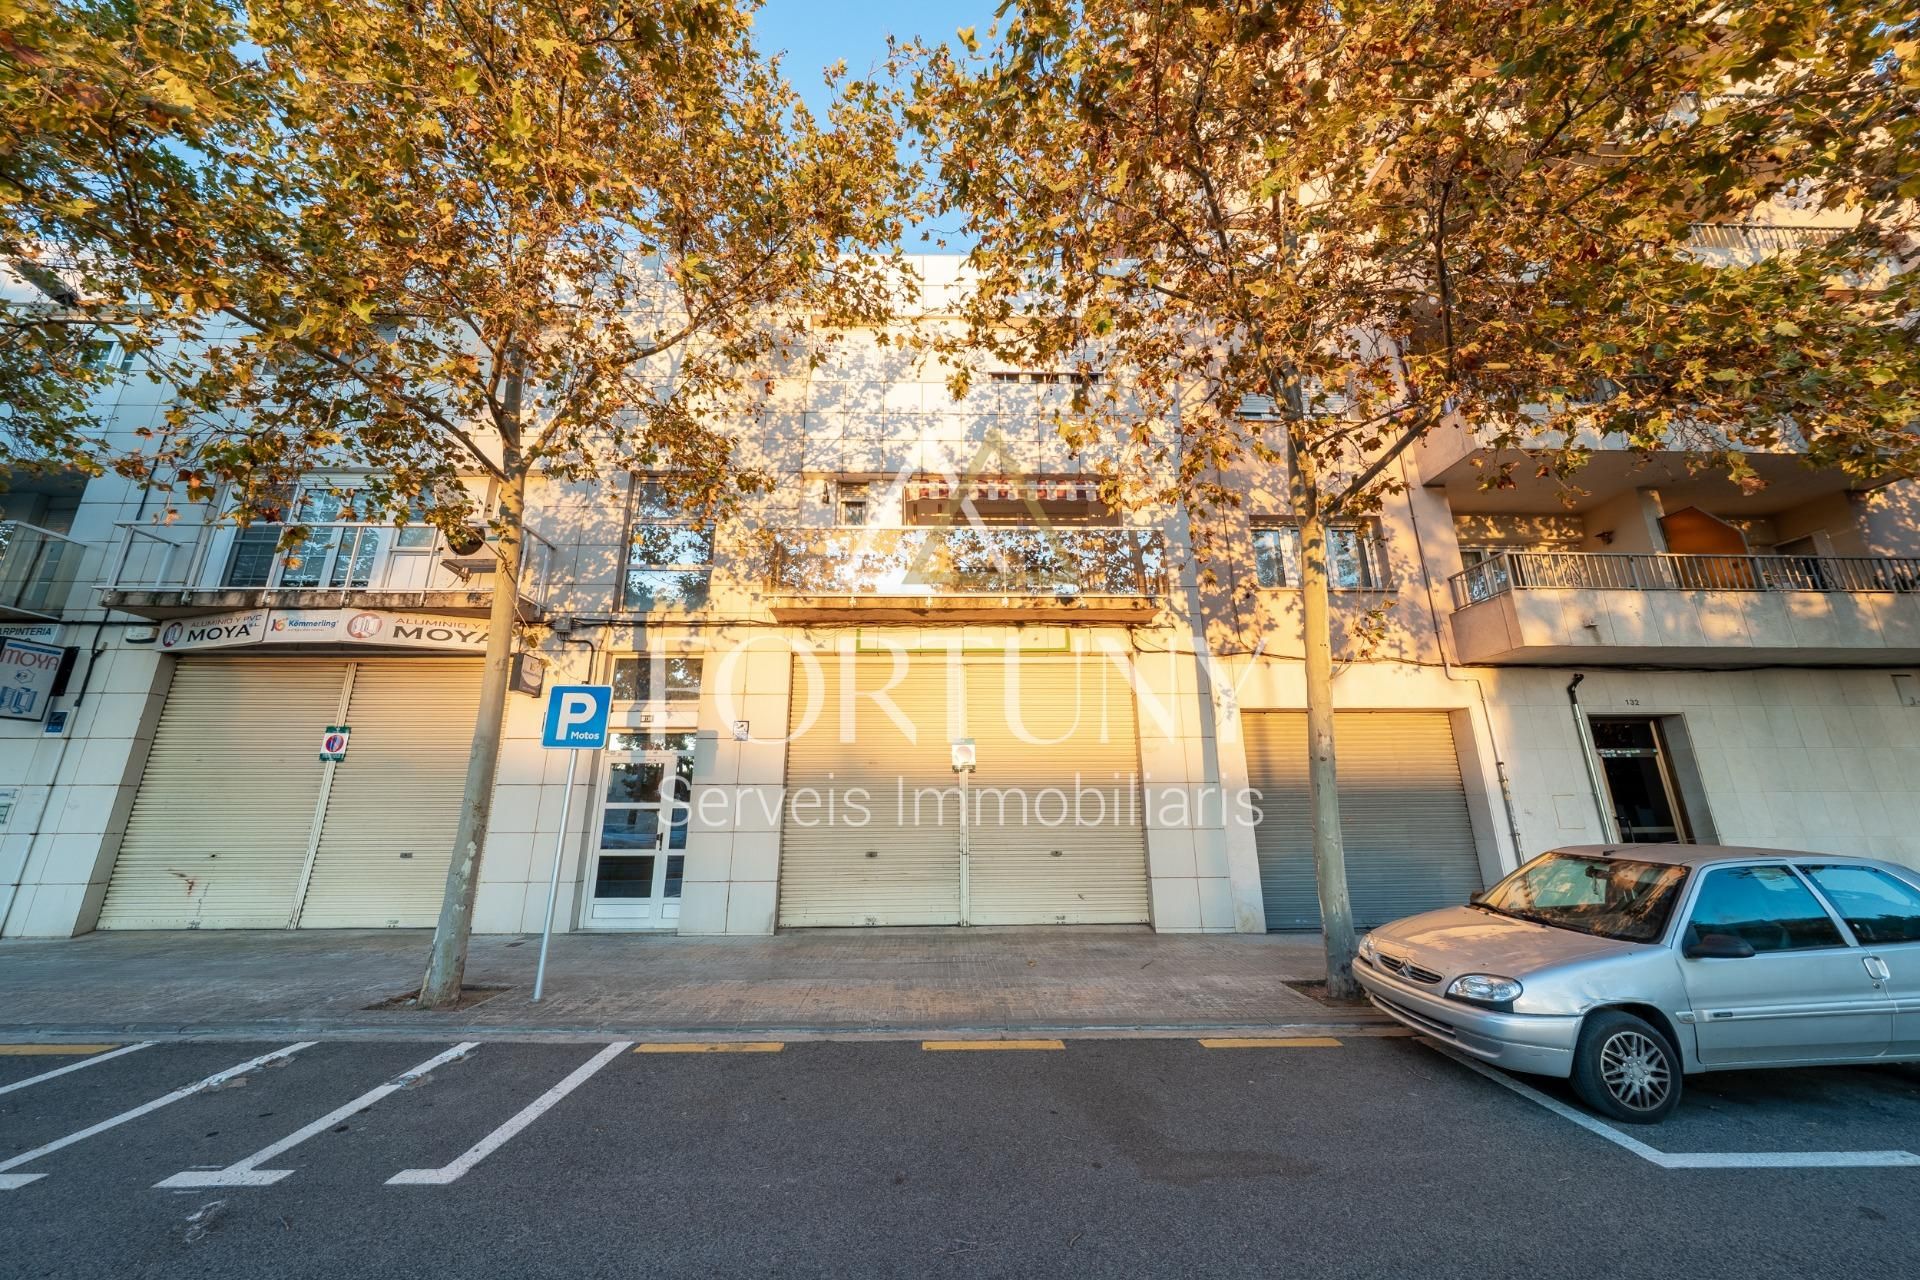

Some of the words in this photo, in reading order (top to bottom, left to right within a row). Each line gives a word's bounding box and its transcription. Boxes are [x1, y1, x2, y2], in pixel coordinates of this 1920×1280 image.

[190, 616, 233, 628] ALUMINIO
[243, 614, 263, 622] PVC
[395, 618, 468, 629] ALUMINIO
[186, 624, 250, 642] MOYA
[0, 648, 60, 671] MOYA
[556, 693, 597, 741] P
[570, 731, 600, 741] Motos
